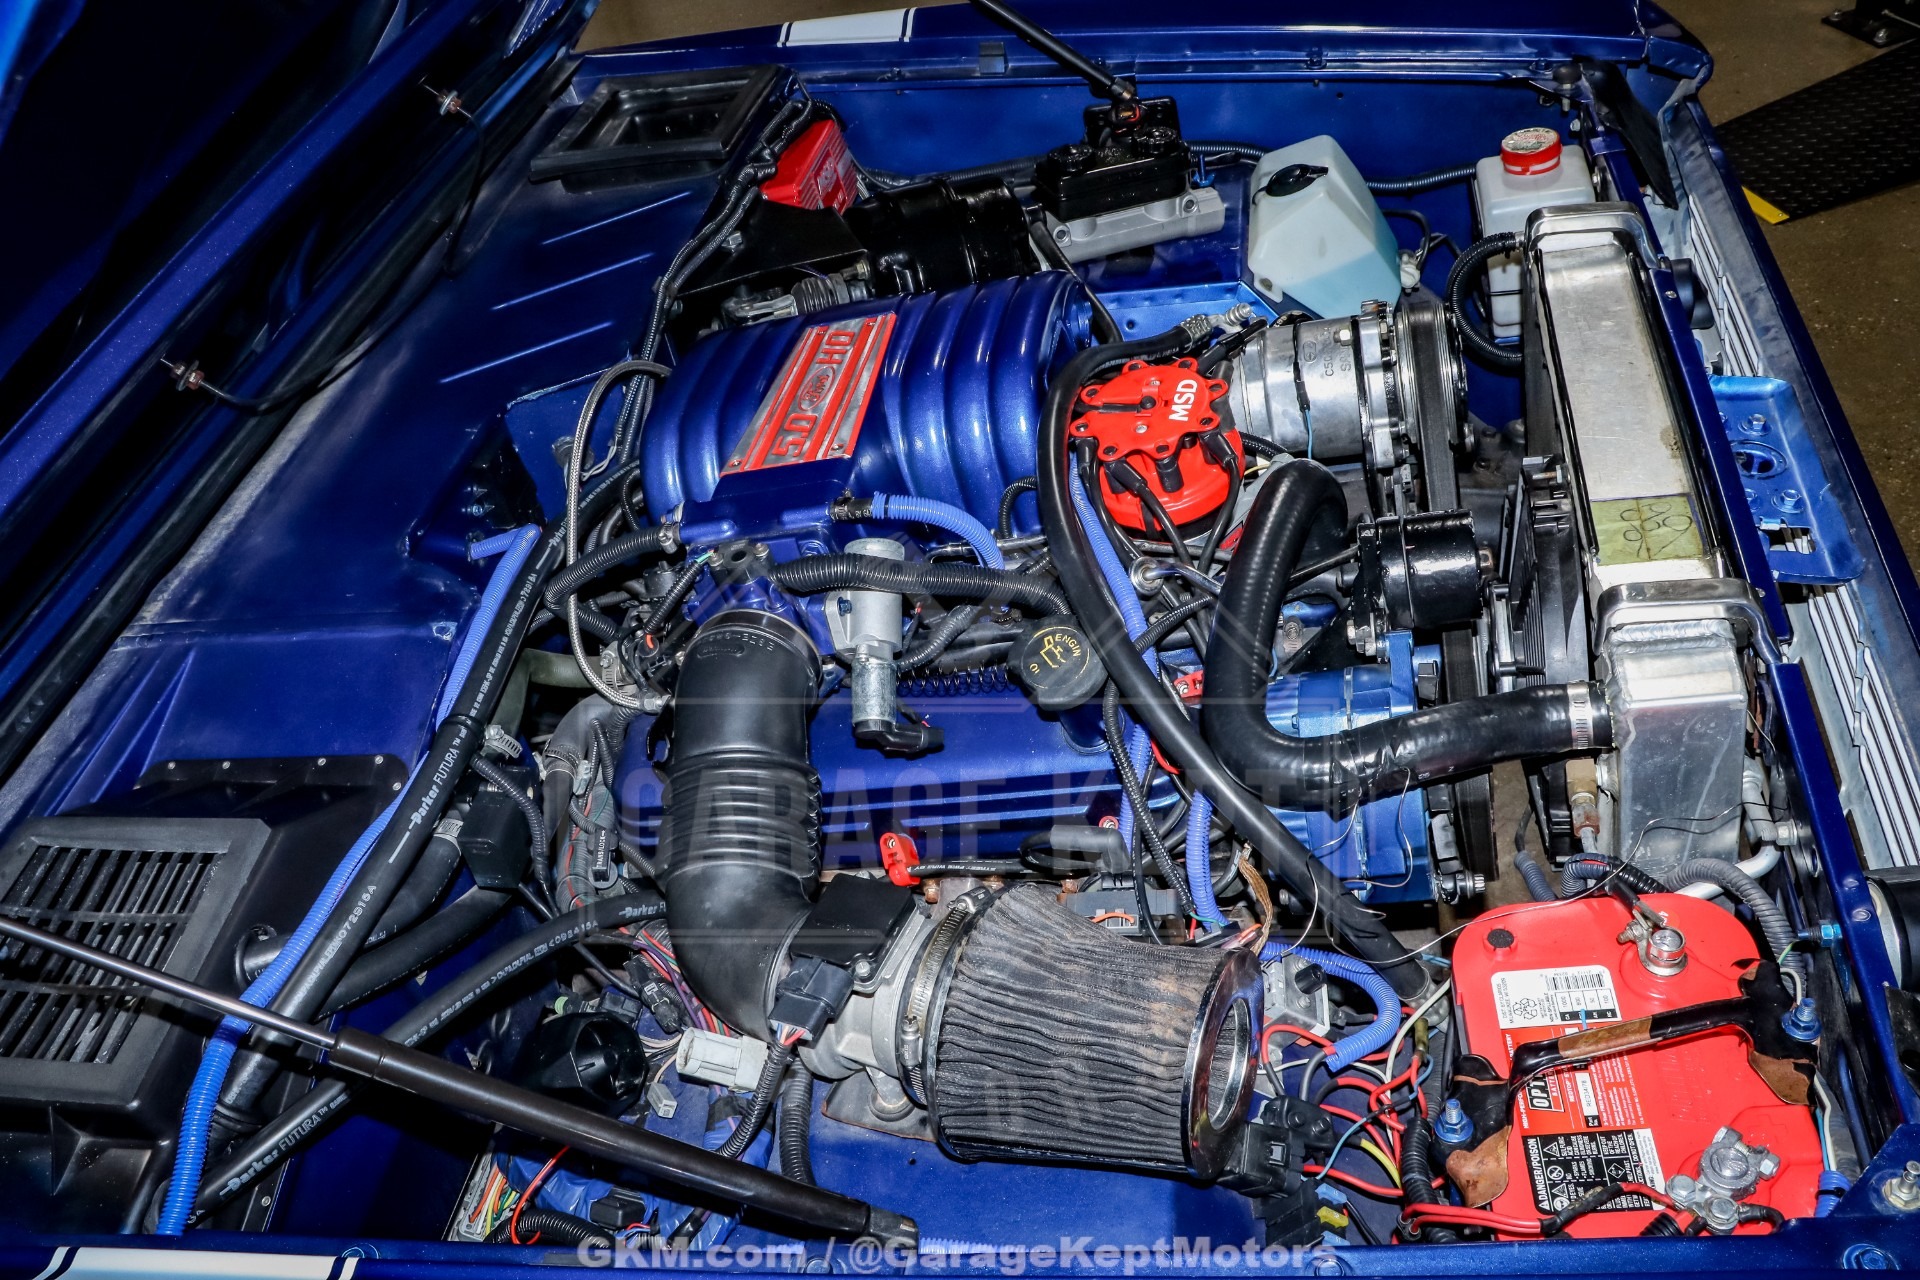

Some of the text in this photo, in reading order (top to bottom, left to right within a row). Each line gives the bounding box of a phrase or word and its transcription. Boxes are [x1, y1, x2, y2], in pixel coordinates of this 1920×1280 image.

[816, 330, 856, 365] HO
[803, 375, 830, 403] Ford
[1169, 380, 1198, 421] MSD
[772, 413, 818, 457] 5.0
[1055, 633, 1082, 657] ENGIN
[1029, 663, 1040, 674] OI
[410, 784, 441, 825] Parker
[432, 747, 460, 786] FUTURA
[625, 904, 658, 918] Parker
[1517, 1092, 1529, 1128] HIGH-PERFO
[227, 1150, 280, 1191] Parker
[278, 1113, 322, 1151] FUTURA
[1527, 1138, 1548, 1200] DANGER/POISON
